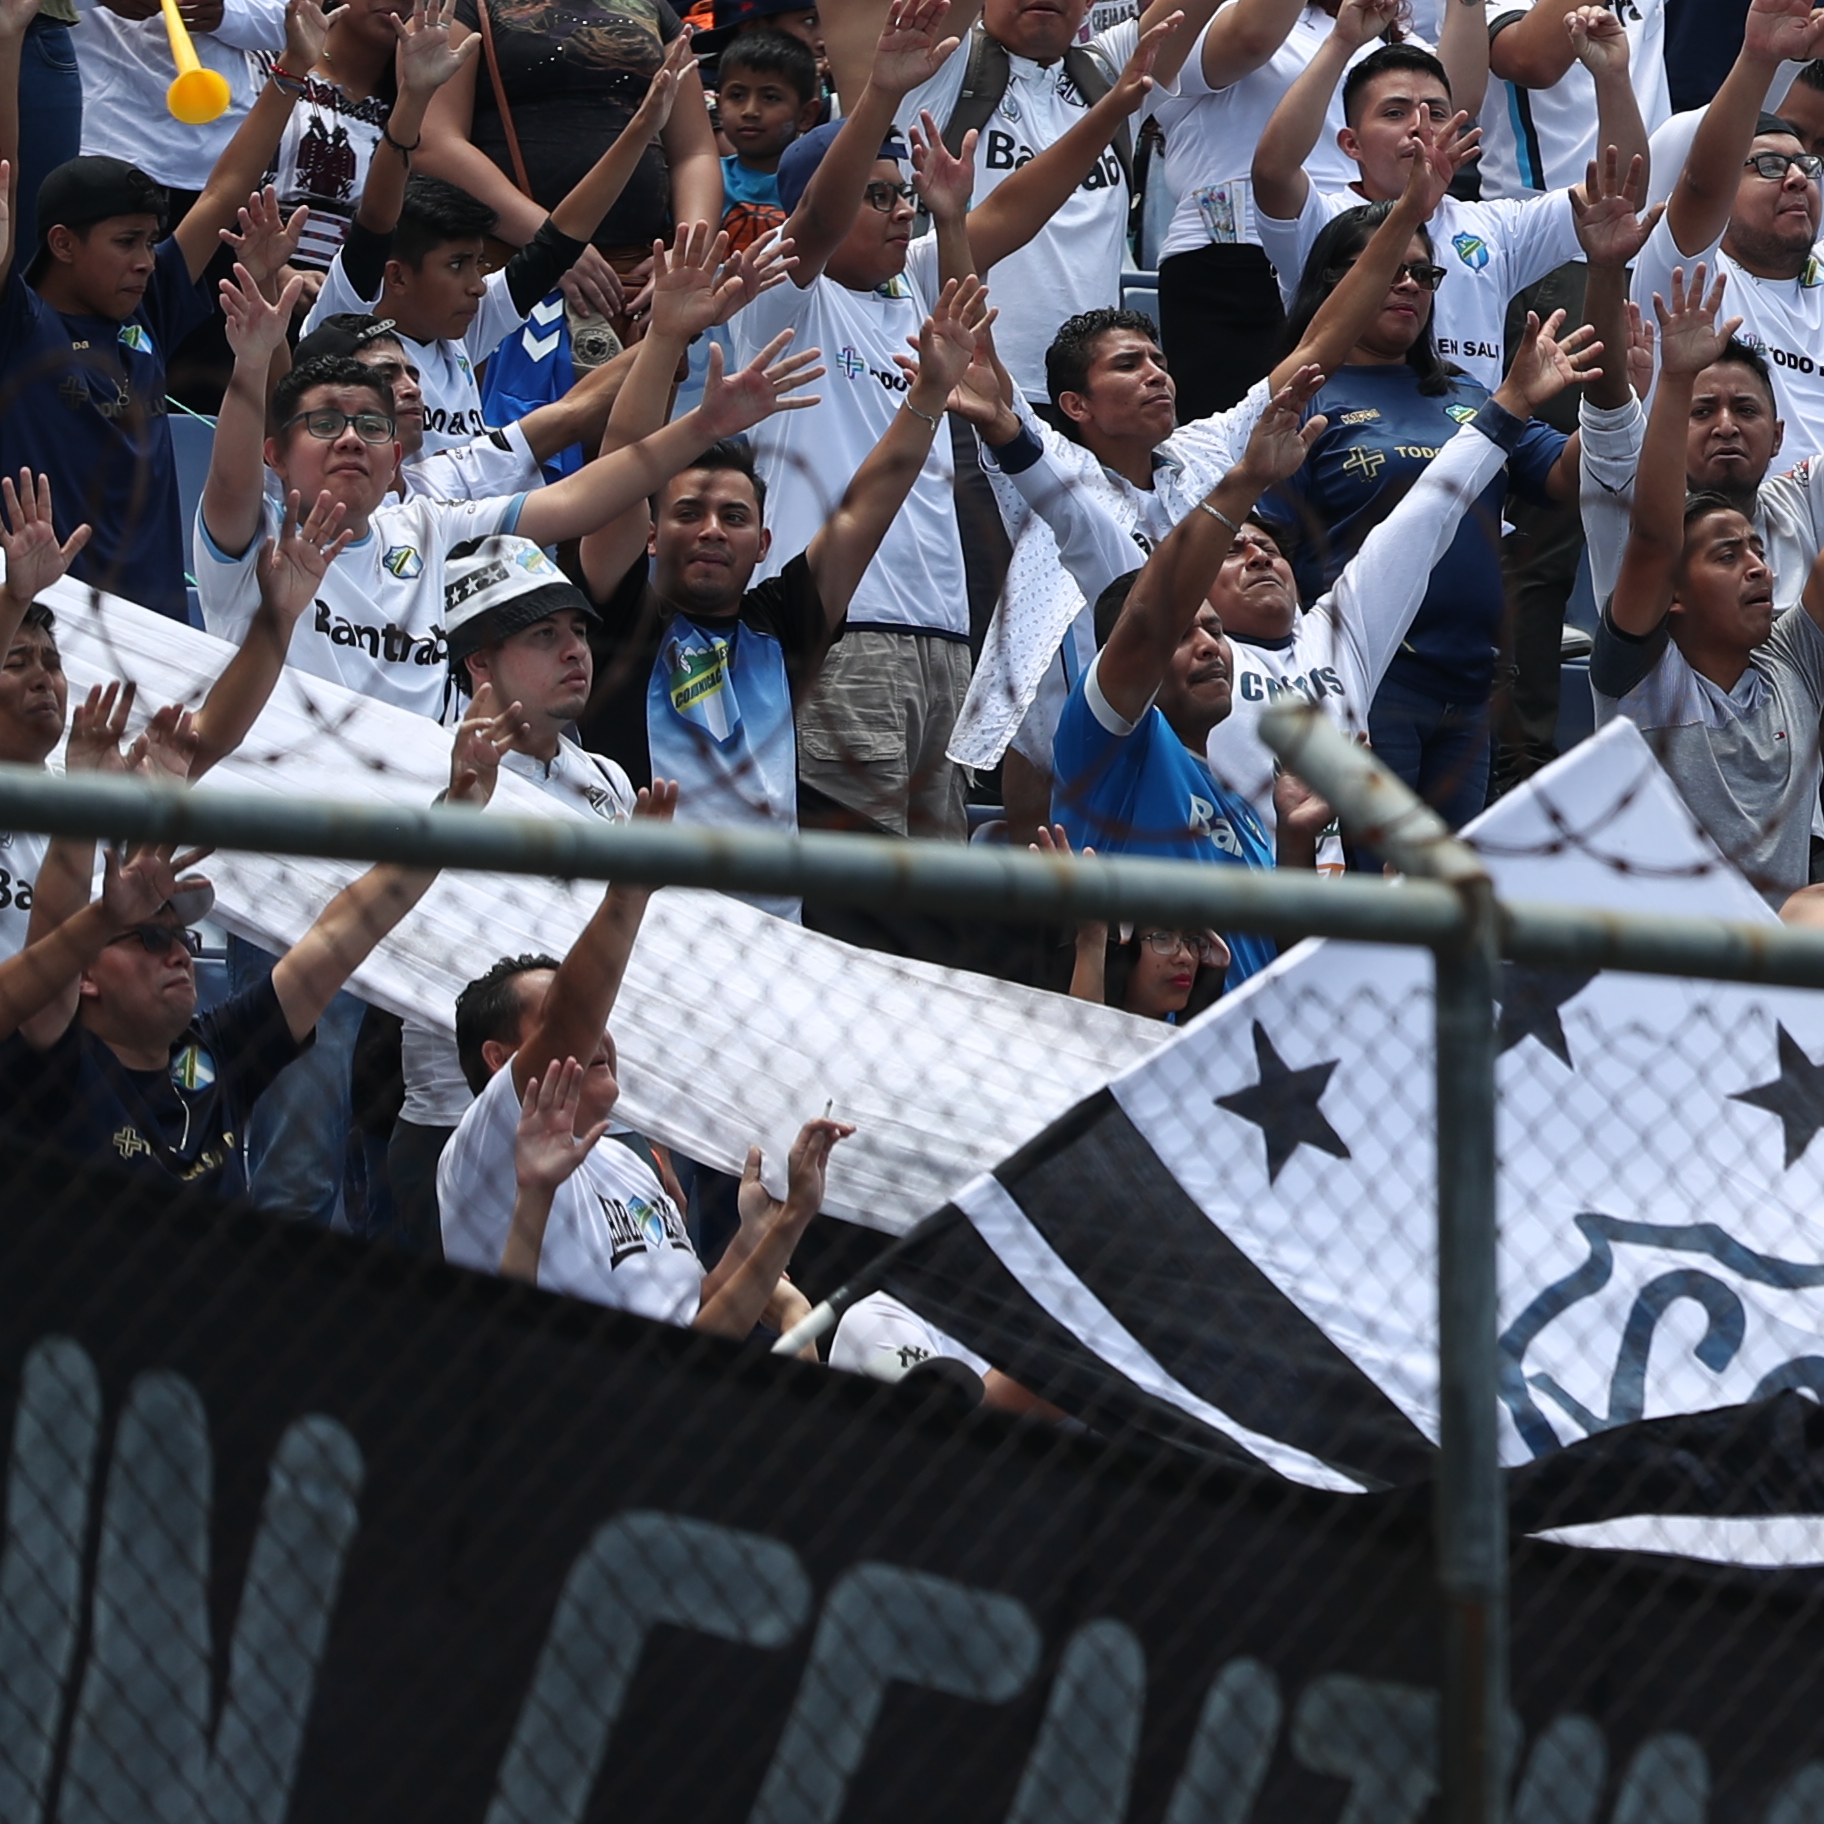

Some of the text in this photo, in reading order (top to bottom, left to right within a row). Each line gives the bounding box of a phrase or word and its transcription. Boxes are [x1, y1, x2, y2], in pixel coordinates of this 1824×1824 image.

[985, 129, 1121, 193] Baab
[1437, 338, 1459, 356] EN
[1768, 347, 1814, 375] ODO
